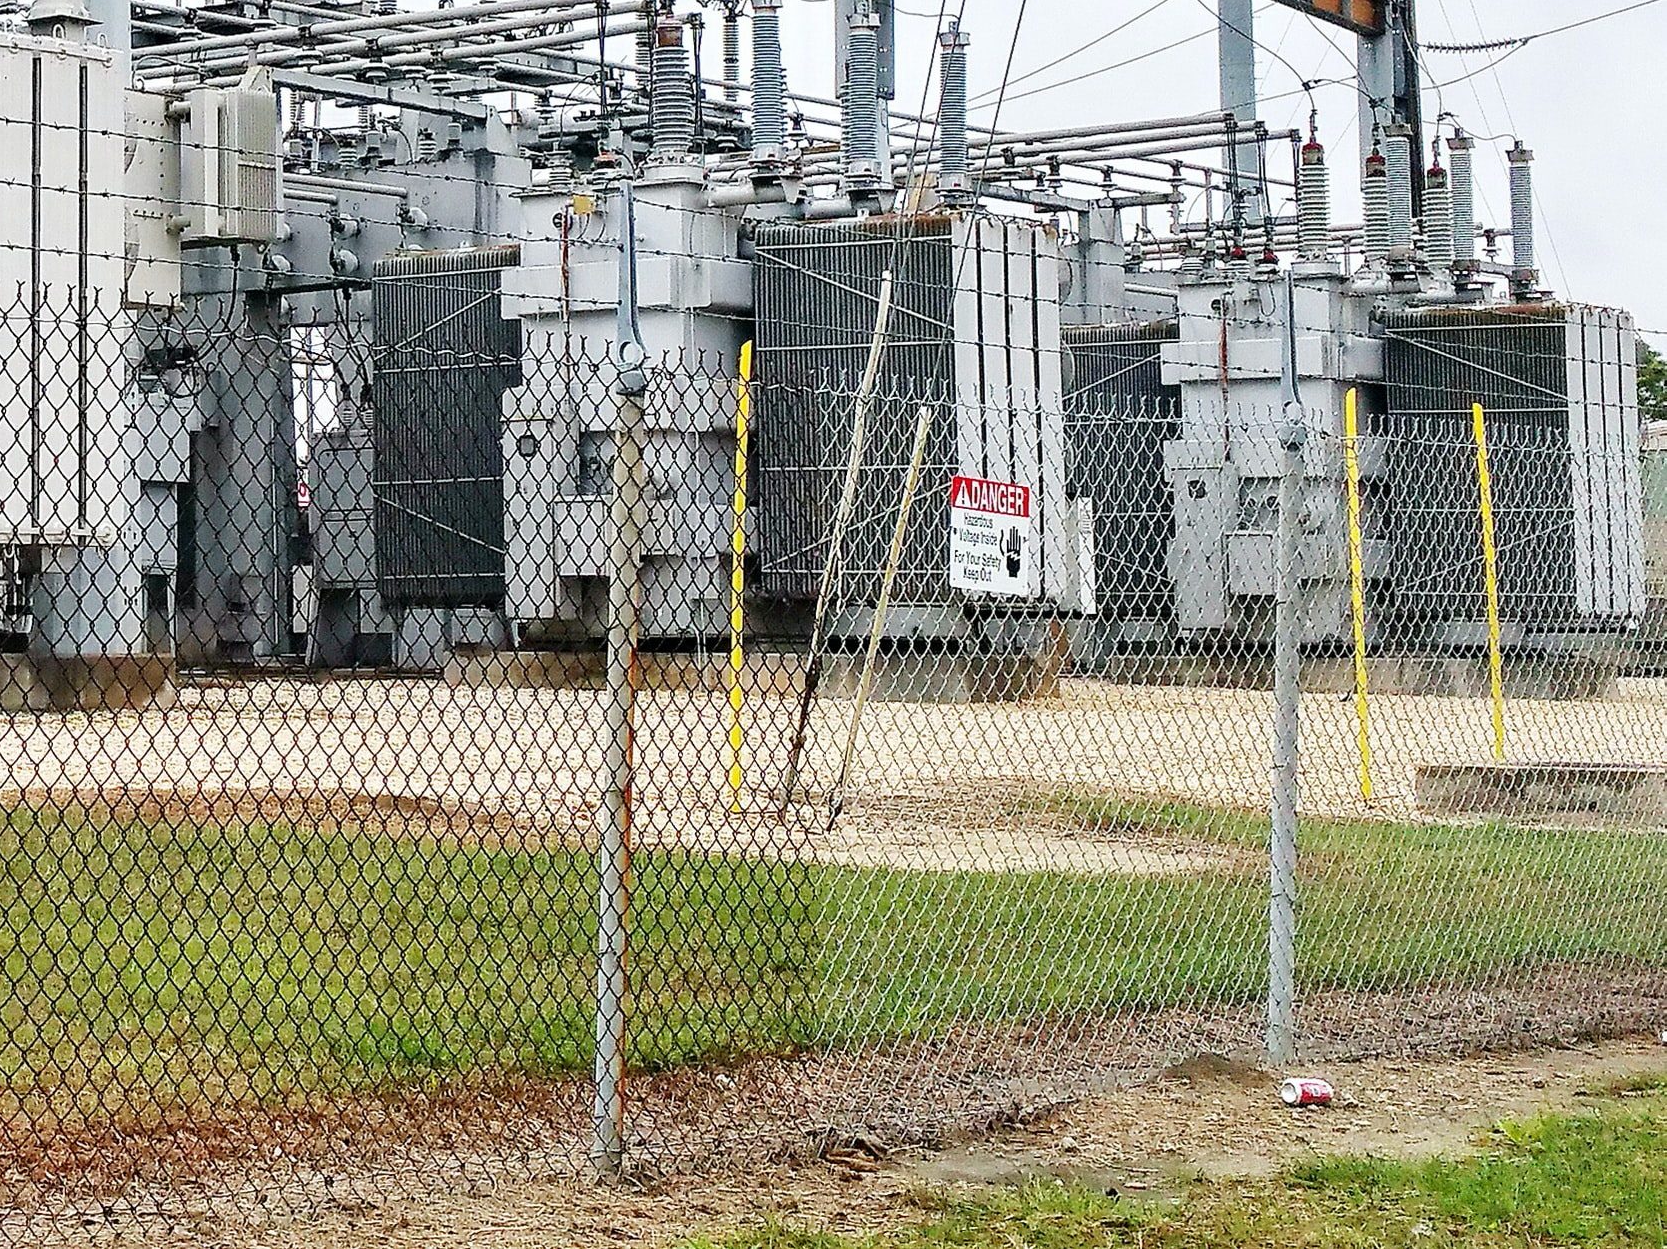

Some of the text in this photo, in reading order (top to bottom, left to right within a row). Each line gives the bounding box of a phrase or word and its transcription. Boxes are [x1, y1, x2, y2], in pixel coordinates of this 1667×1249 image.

[971, 480, 1024, 515] DANGER
[963, 512, 994, 529] Hazardous
[959, 527, 980, 547] Voltage
[954, 549, 1002, 572] For Your Safety
[962, 565, 992, 584] Keep Out
